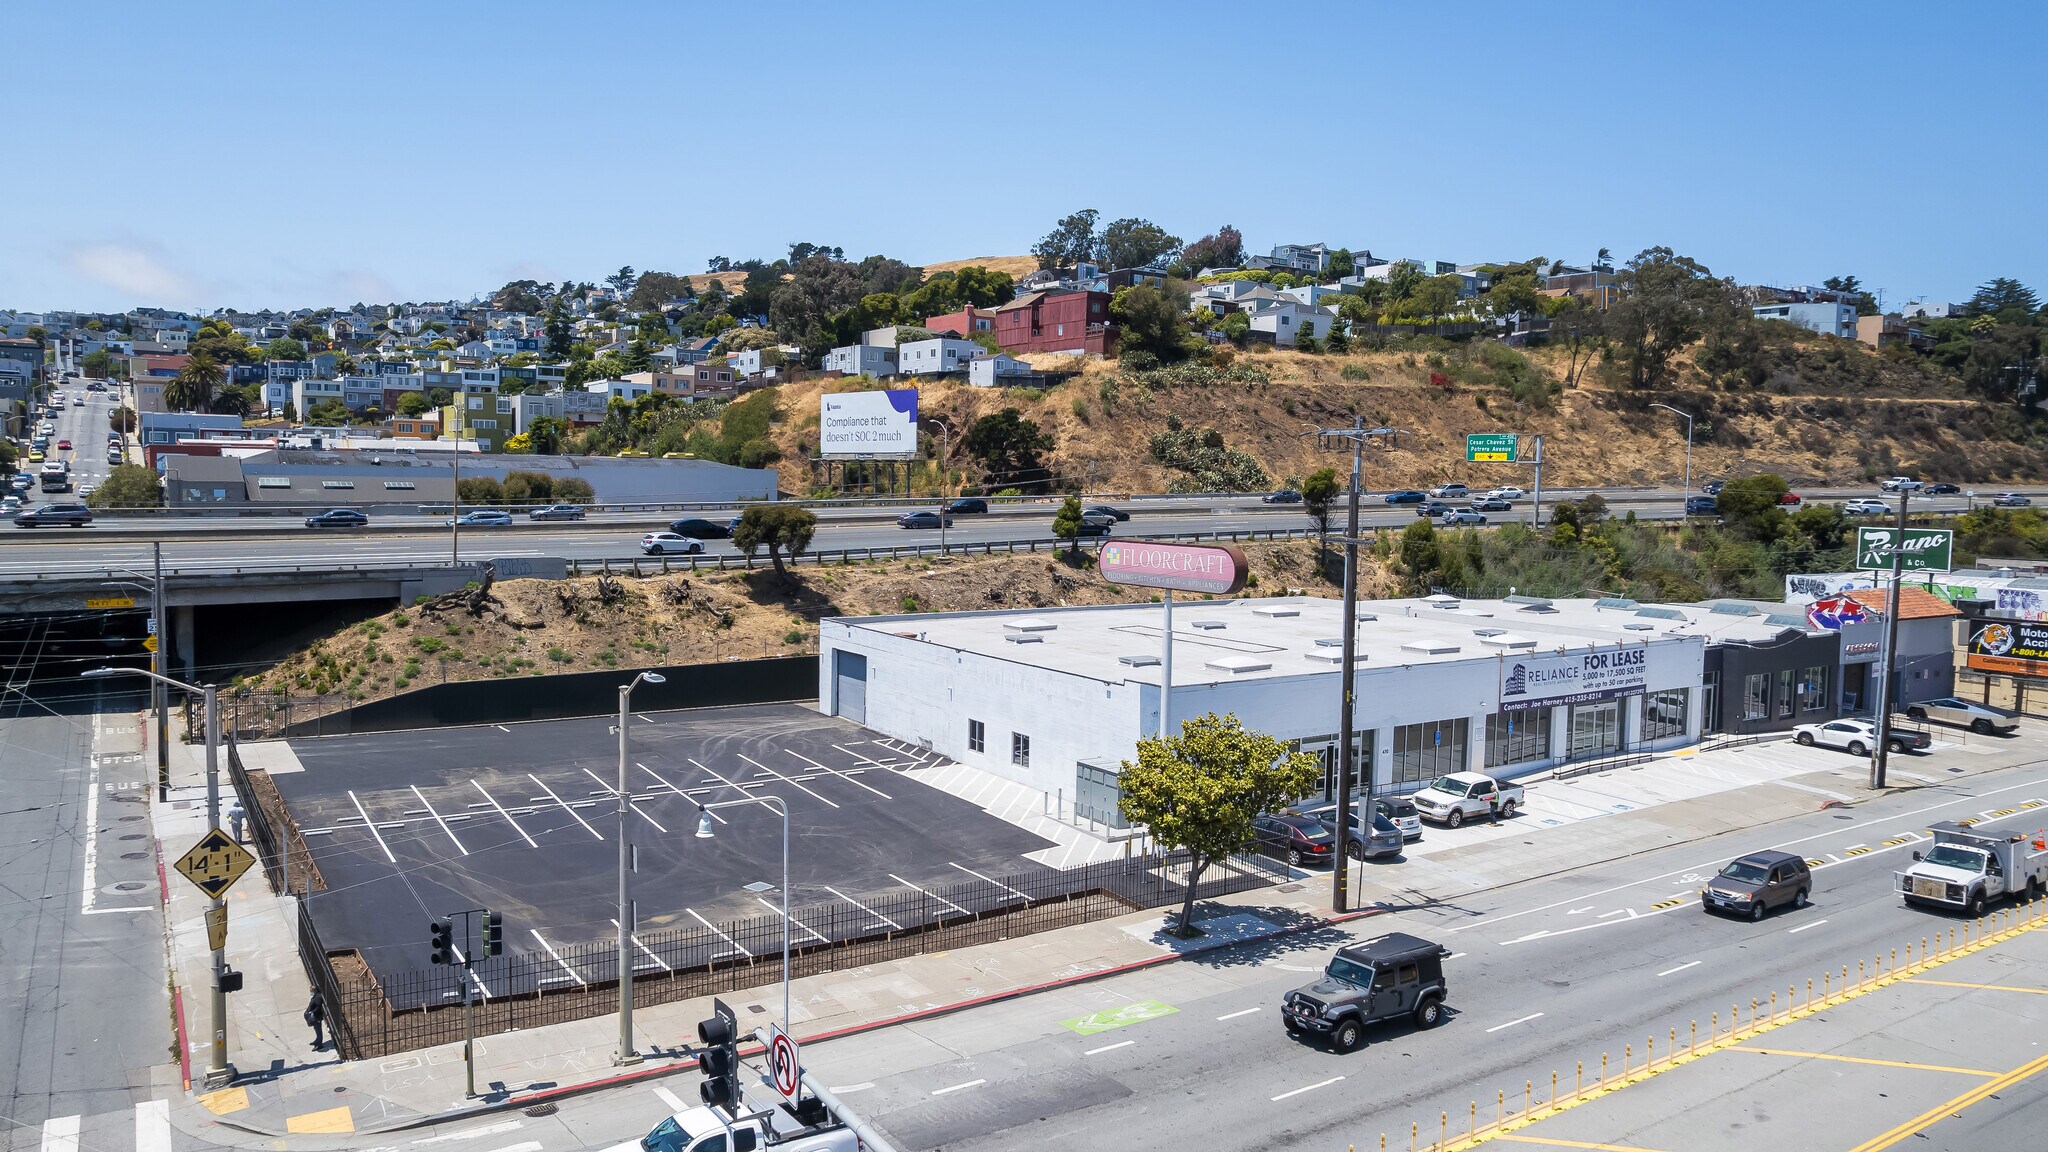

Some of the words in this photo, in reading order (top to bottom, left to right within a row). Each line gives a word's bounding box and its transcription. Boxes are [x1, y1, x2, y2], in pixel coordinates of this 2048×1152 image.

[826, 416, 870, 428] Compliance
[871, 416, 887, 426] that
[826, 431, 854, 442] doesn't
[855, 431, 871, 442] SOC
[872, 431, 878, 442] 2
[879, 430, 902, 441] much
[1863, 531, 1948, 565] Roano
[1122, 548, 1227, 574] FLOORCRAFT
[1907, 558, 1913, 566] &
[1107, 572, 1134, 581] FLOORING
[1138, 575, 1163, 583] KITCHEN
[1165, 577, 1182, 585] BATH
[1187, 580, 1224, 590] APPLIANCES
[1584, 654, 1608, 671] FOR
[1612, 649, 1645, 668] LEASE
[1528, 666, 1579, 682] RELIANCE
[1582, 671, 1598, 681] 5,000
[1607, 668, 1625, 679] 17,500
[1626, 667, 1635, 676] SQ
[1635, 666, 1646, 674] FEET
[1582, 681, 1594, 690] with
[1595, 681, 1602, 689] up
[1625, 676, 1644, 686] parking
[1503, 703, 1528, 711] Contact:
[1542, 698, 1563, 707] Harney
[105, 727, 137, 735] BUS
[102, 755, 144, 764] STOP
